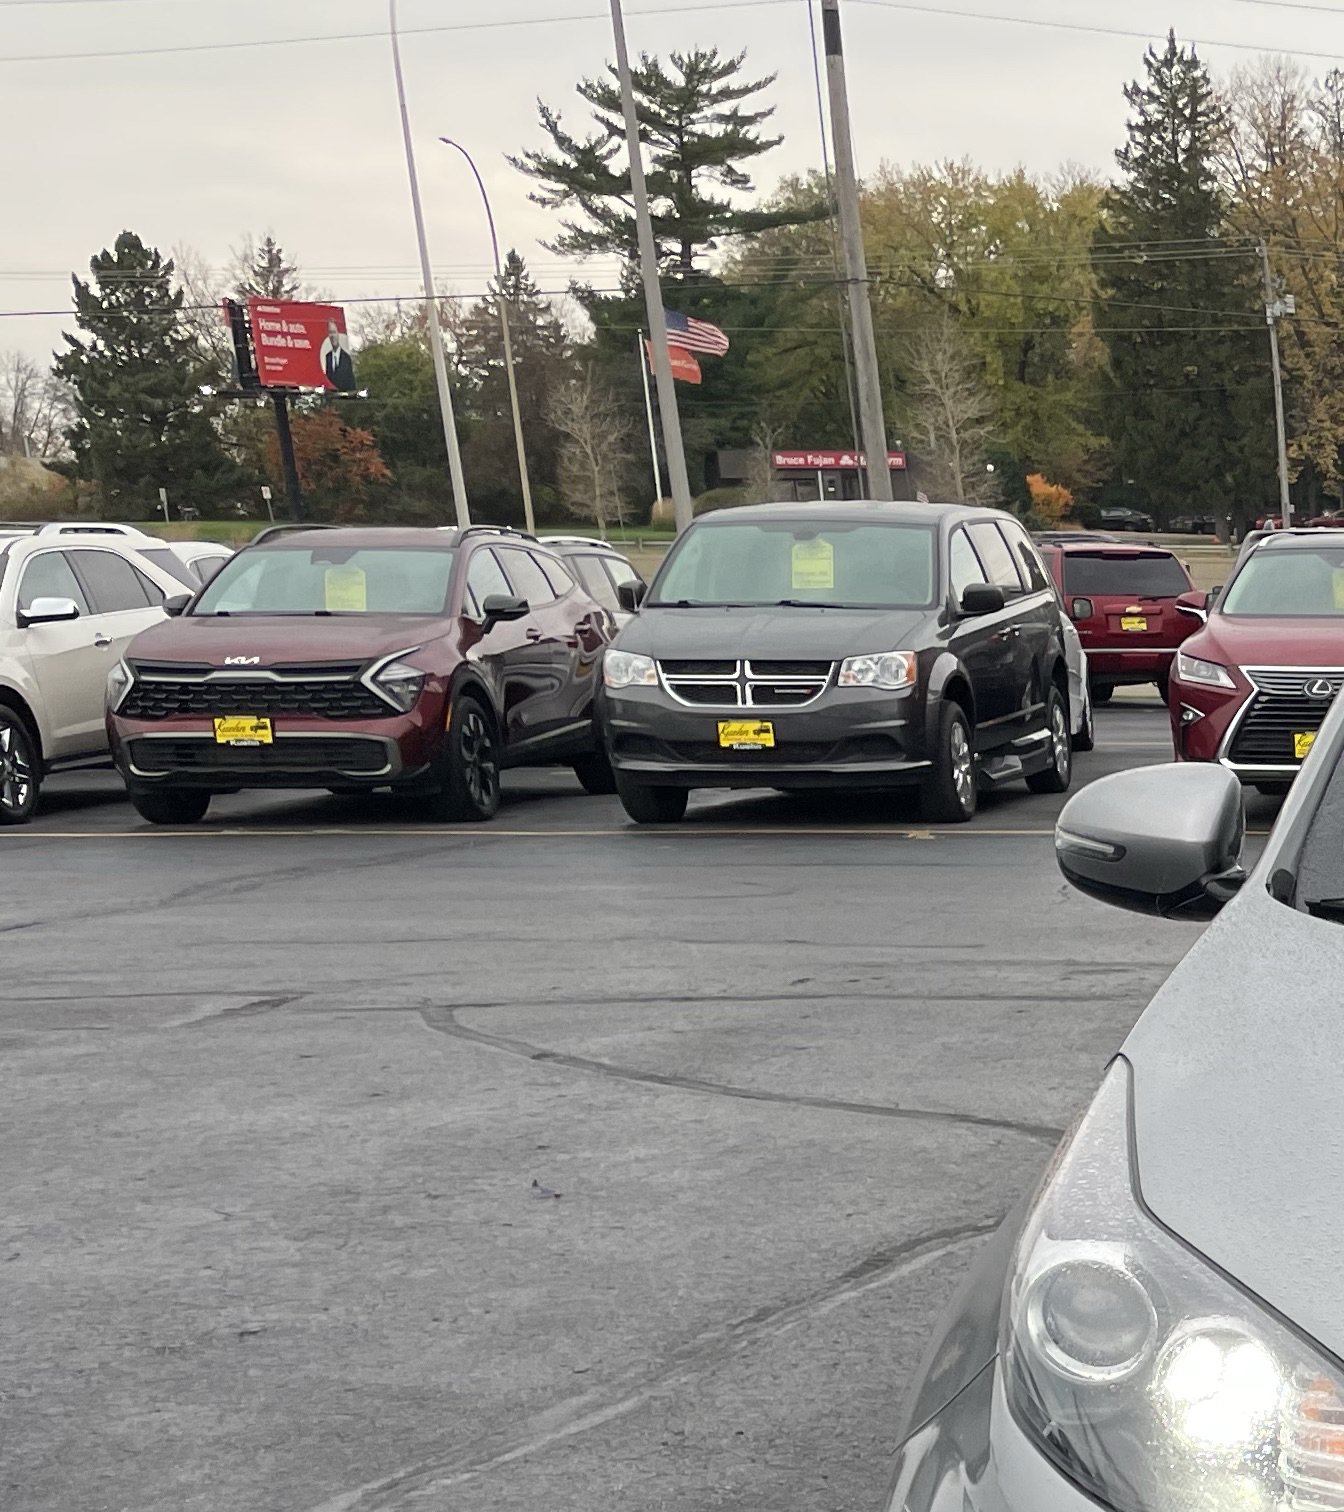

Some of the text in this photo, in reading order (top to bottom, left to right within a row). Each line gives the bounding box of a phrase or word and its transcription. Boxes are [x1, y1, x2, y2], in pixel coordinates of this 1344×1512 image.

[258, 318, 281, 332] Home
[261, 333, 287, 347] Bundle
[775, 455, 804, 465] Bruce
[807, 455, 835, 467] Fujan
